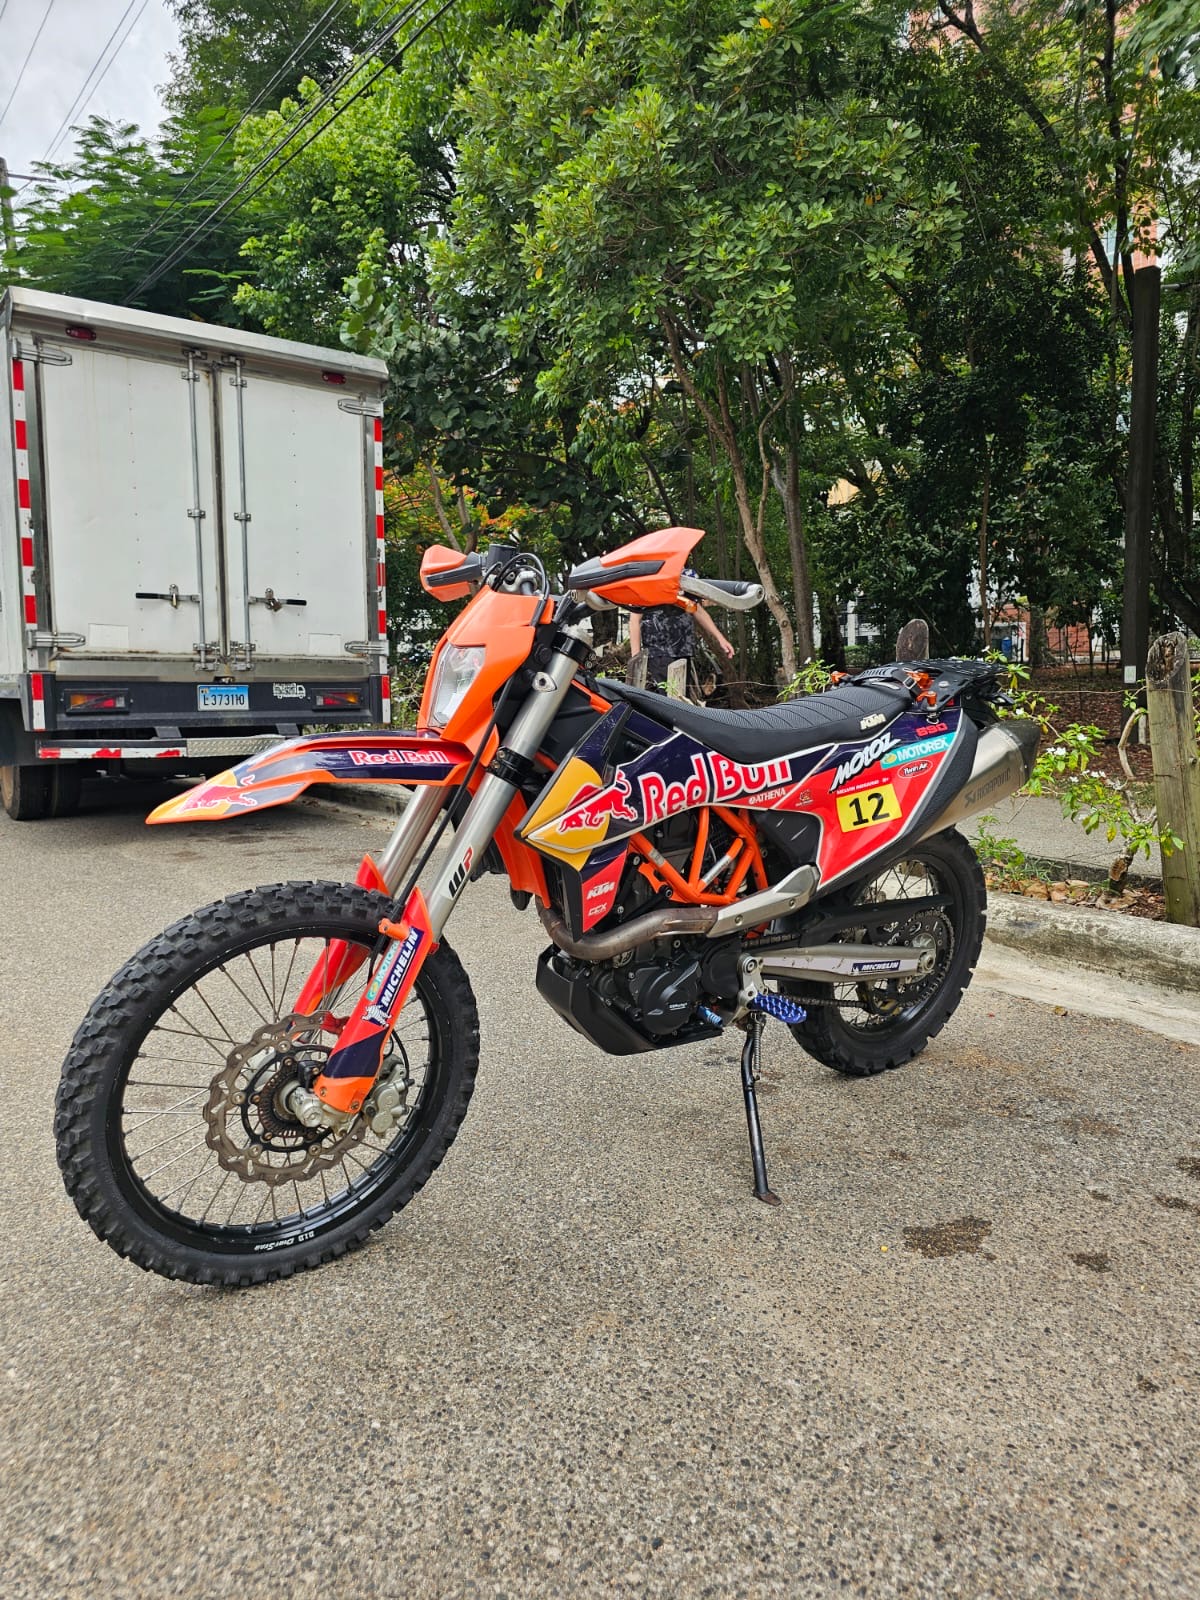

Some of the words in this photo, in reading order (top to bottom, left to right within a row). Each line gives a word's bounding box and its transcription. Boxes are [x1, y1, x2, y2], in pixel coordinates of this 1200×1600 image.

[203, 694, 245, 706] L373110
[860, 713, 886, 730] KTM
[916, 722, 948, 737] 690
[348, 750, 404, 766] Red
[399, 750, 450, 764] Bull
[897, 738, 949, 762] MOTOREX
[637, 753, 710, 826] Red
[706, 750, 793, 802] Bull
[849, 792, 890, 826] 12
[586, 881, 616, 900] KTM
[381, 927, 419, 1008] MICHELIN
[861, 962, 899, 971] MICHELIN
